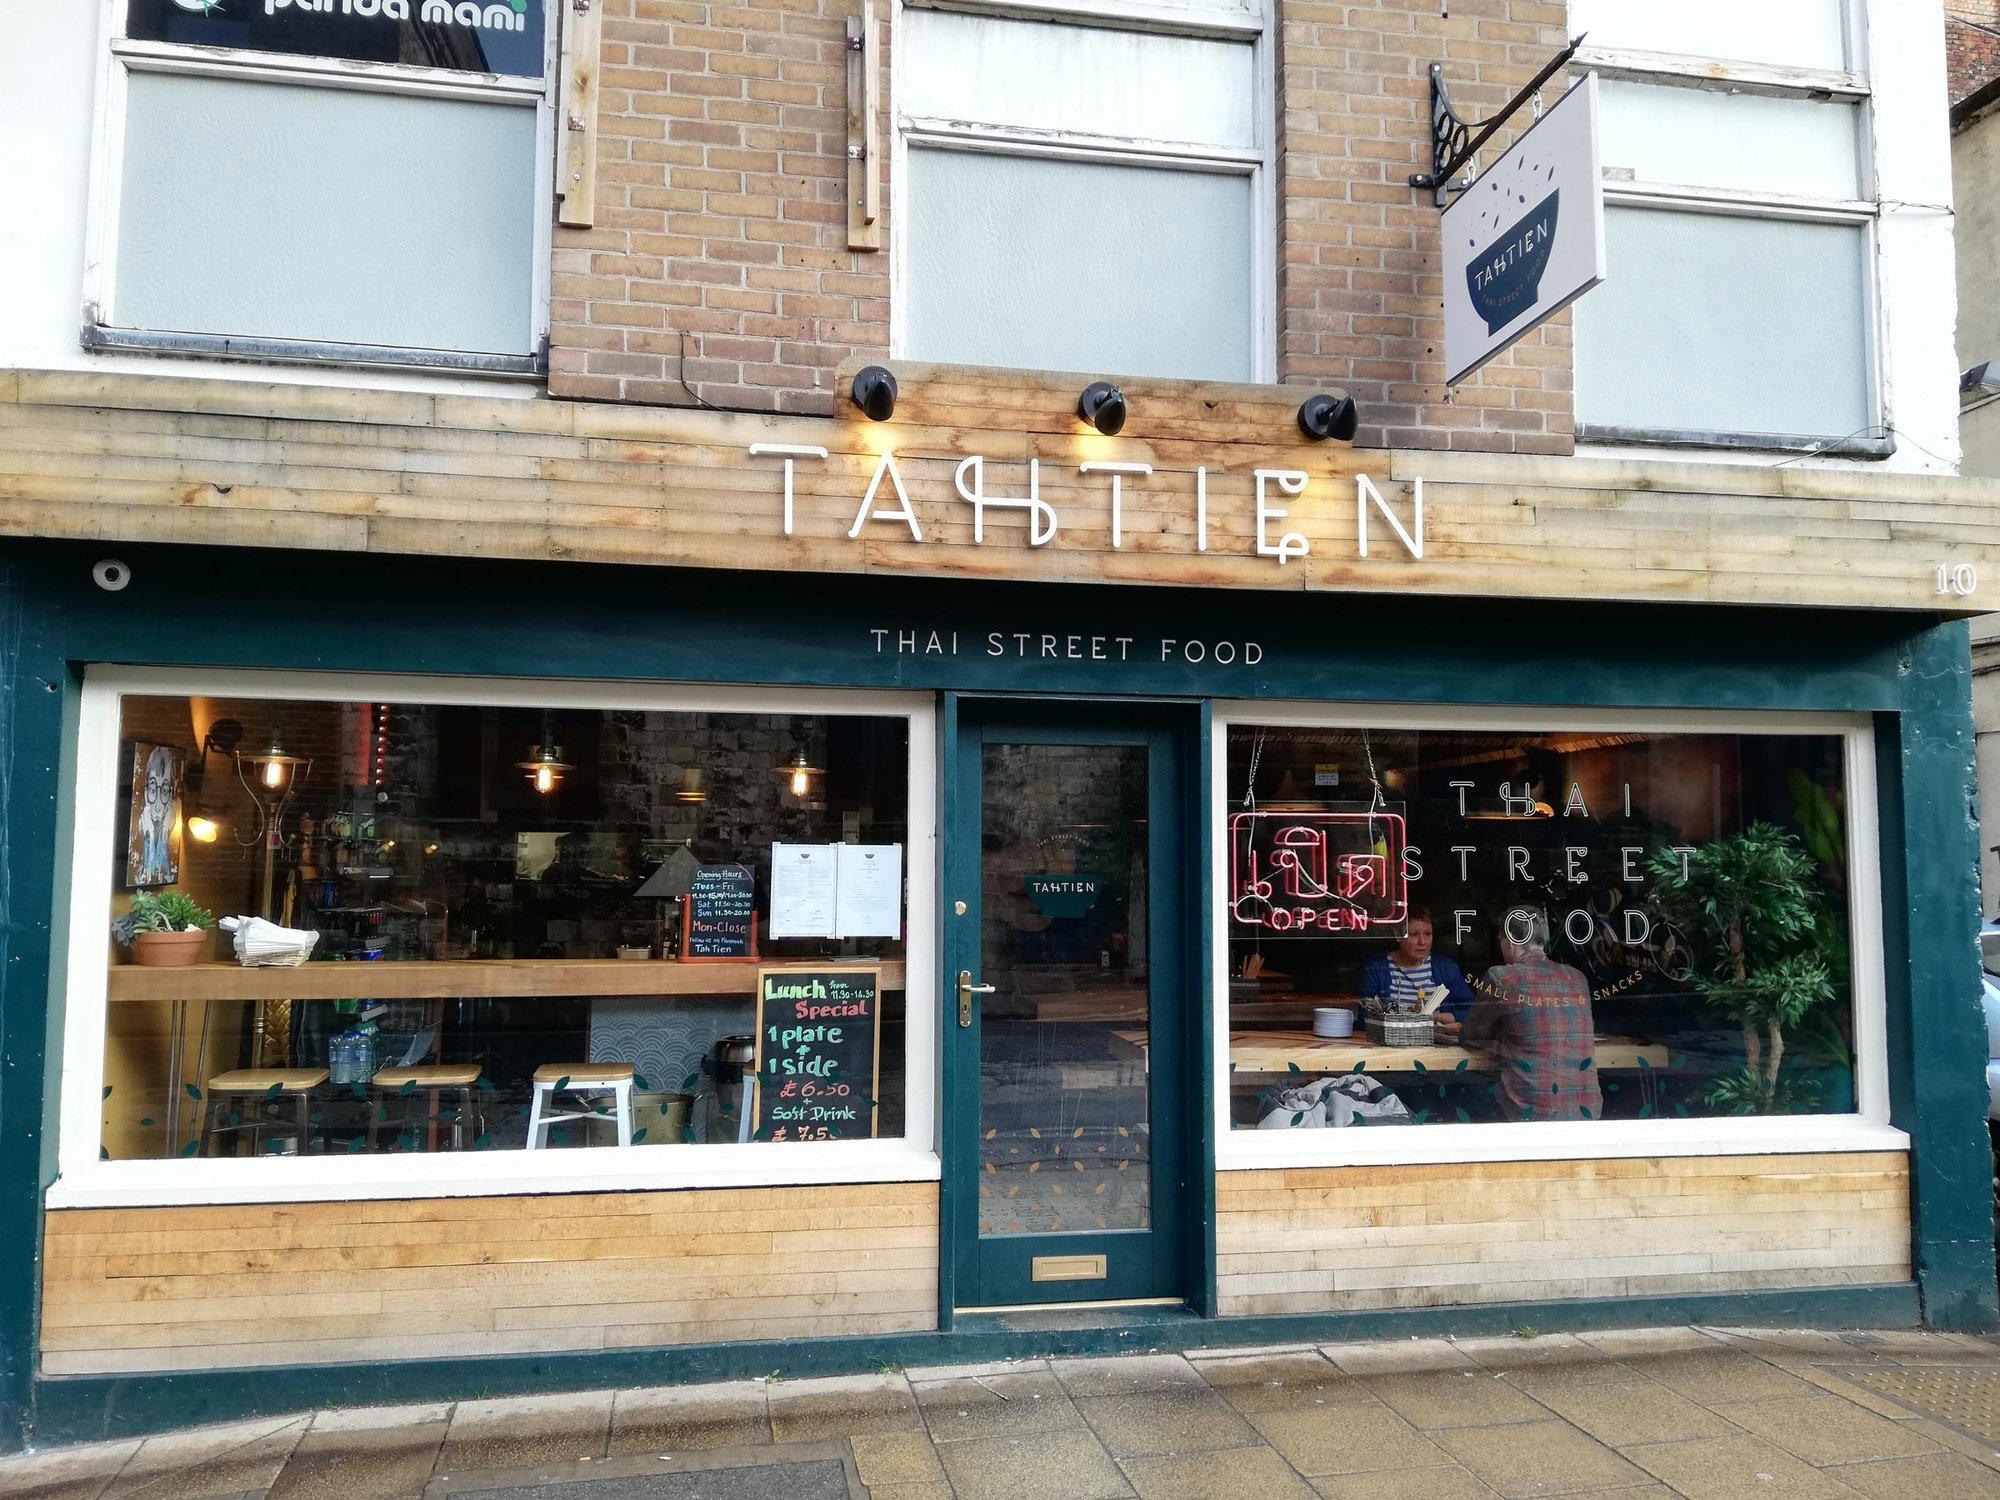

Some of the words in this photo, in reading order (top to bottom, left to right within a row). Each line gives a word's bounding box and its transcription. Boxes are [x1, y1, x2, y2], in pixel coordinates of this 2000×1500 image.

[421, 0, 527, 31] mami
[1475, 218, 1548, 291] TAHTIEN
[749, 443, 1424, 565] TAHTIEN
[1935, 563, 1977, 596] 10
[871, 629, 957, 655] THAI
[987, 632, 1133, 661] STREET
[1161, 639, 1263, 665] FOOD
[1450, 781, 1630, 817] THAI
[697, 870, 721, 880] Opening
[1400, 846, 1697, 884] STREET
[1033, 882, 1094, 893] TAHTIEN
[697, 909, 712, 917] Sun
[1272, 908, 1368, 931] OPEN
[1454, 909, 1650, 945] FOOD
[695, 944, 711, 953] Tah
[711, 944, 732, 953] Tien
[764, 977, 827, 1000] Lunch
[1464, 973, 1509, 1001] SMALL
[1518, 994, 1570, 1007] PLATES
[1593, 970, 1643, 1001] SNACKS
[795, 1000, 869, 1020] Special
[768, 1026, 777, 1042] 1
[782, 1026, 844, 1049] plate
[769, 1058, 777, 1073] 1
[782, 1055, 838, 1077] side
[772, 1106, 808, 1120] Soft
[809, 1105, 857, 1121] Drink
